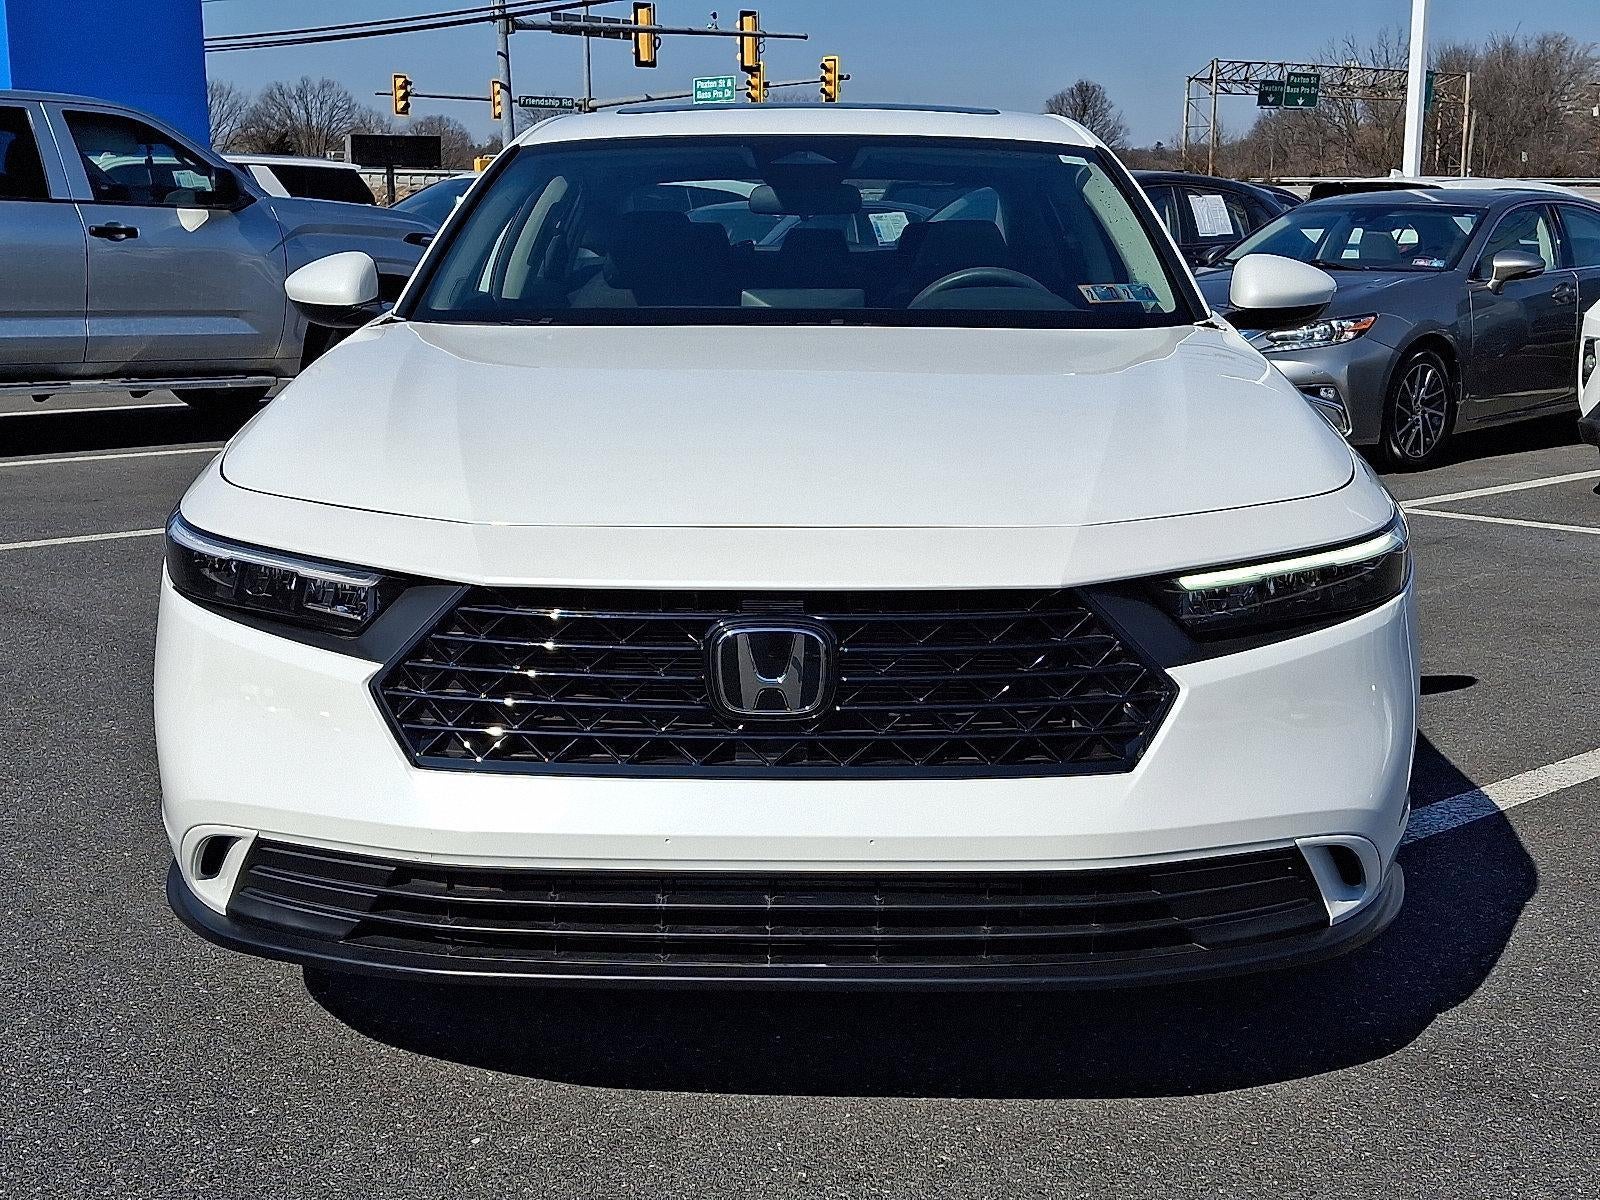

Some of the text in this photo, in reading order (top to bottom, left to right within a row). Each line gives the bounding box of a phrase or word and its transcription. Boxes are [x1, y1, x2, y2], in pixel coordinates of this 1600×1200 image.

[696, 80, 717, 88] Paxton
[719, 79, 726, 88] St
[696, 89, 732, 98] Bass Pro Dr
[520, 96, 572, 107] Friendship Rd
